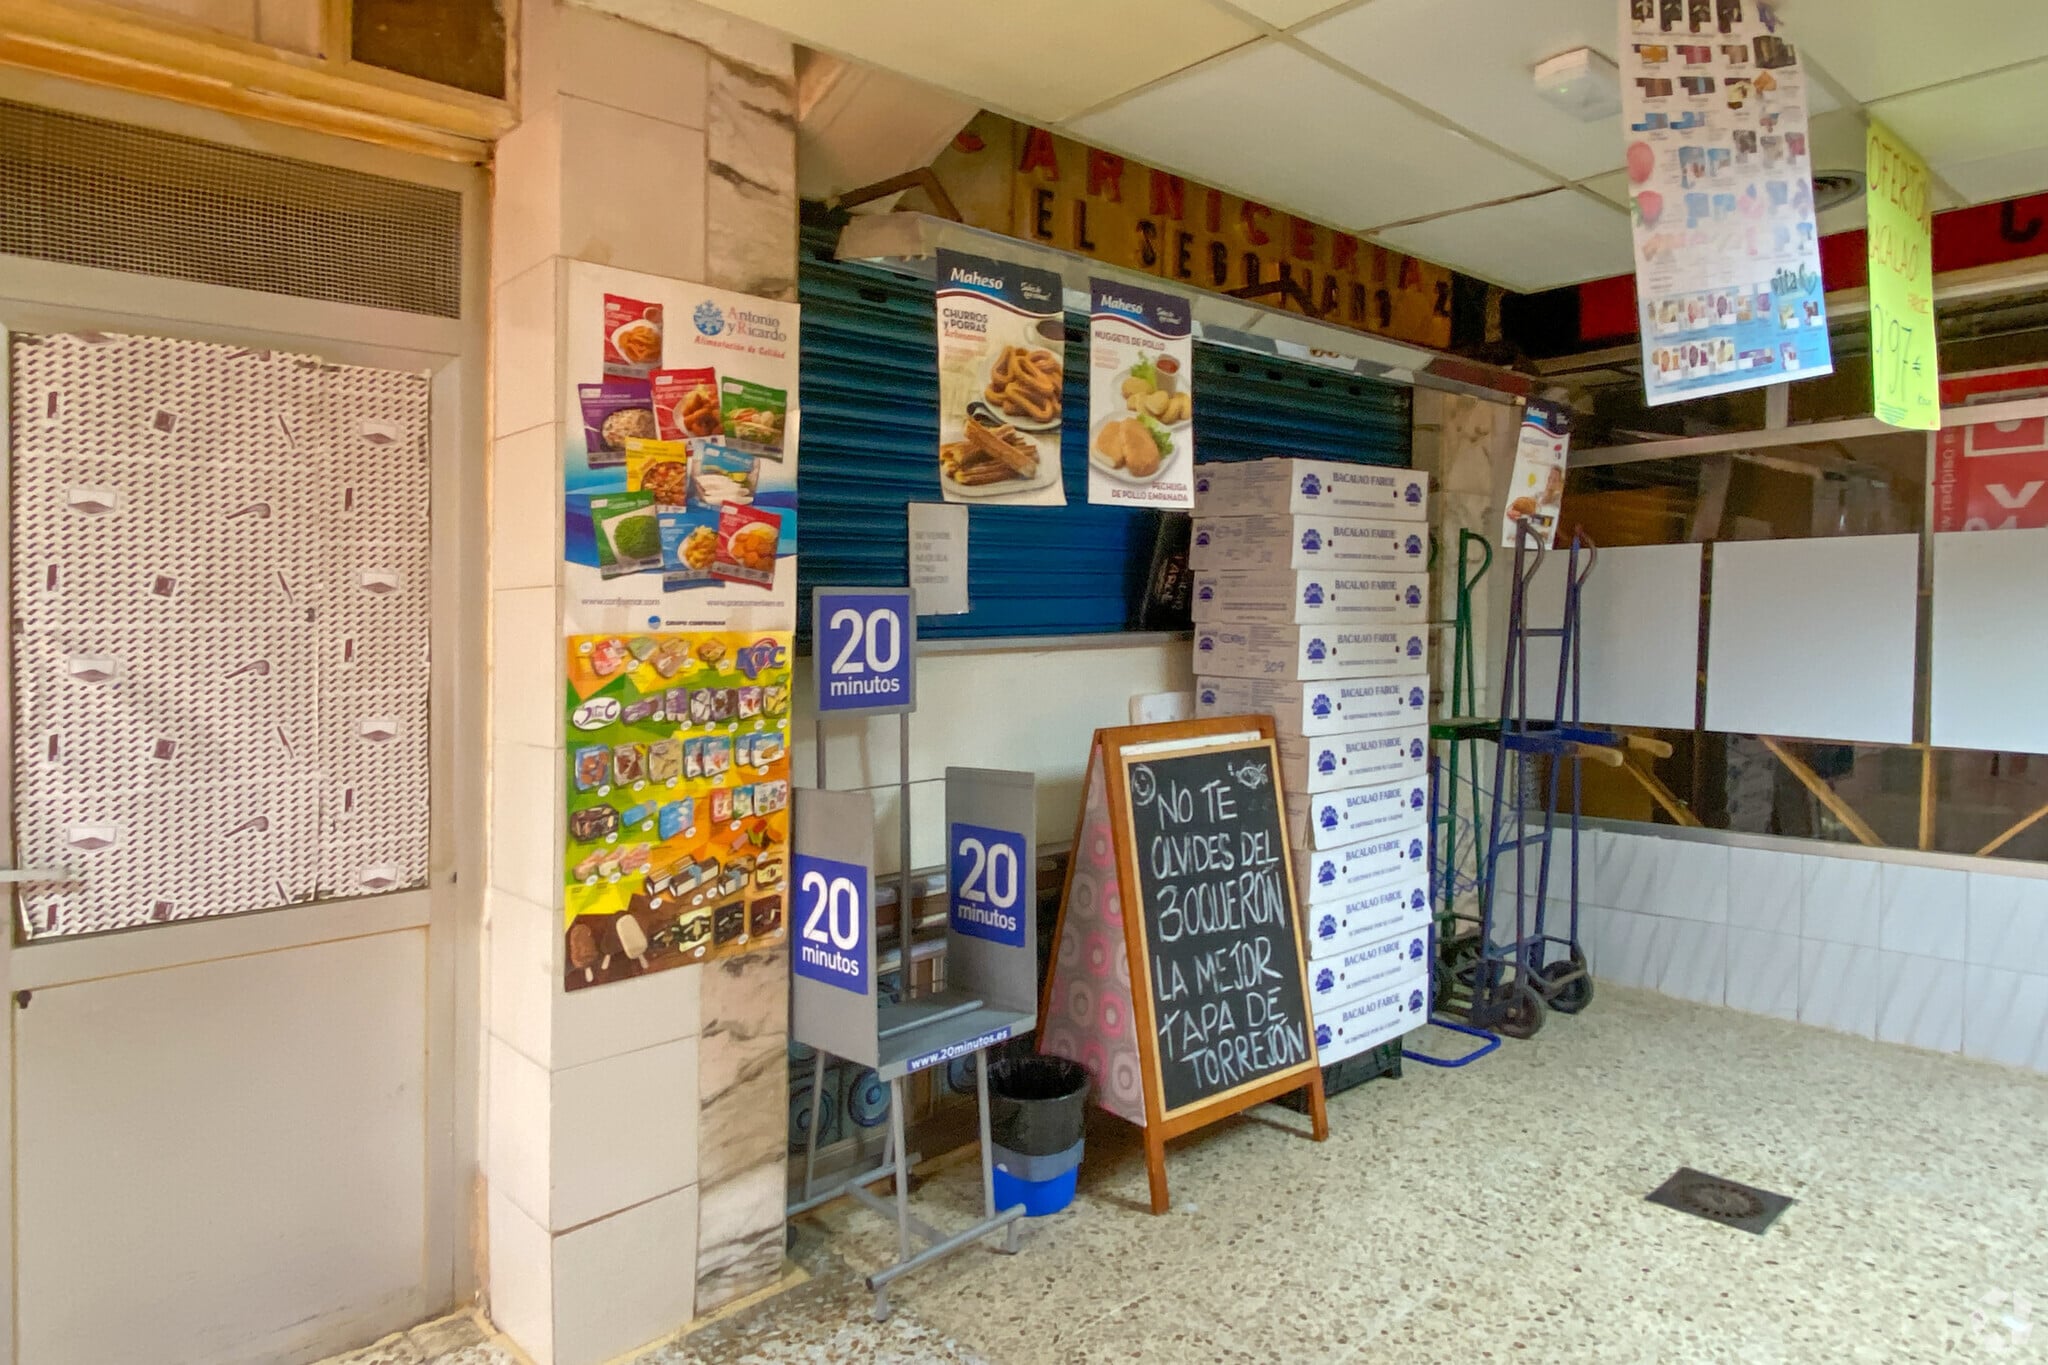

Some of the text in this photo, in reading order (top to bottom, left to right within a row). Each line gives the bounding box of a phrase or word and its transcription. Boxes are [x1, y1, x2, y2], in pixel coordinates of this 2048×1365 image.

[1033, 187, 1096, 251] EL
[950, 267, 1004, 290] Maheso
[1101, 294, 1143, 314] Maheso
[728, 306, 780, 328] Antonio
[943, 308, 988, 323] CHURROS
[951, 319, 987, 333] PORRAS
[1095, 330, 1130, 345] NUGGETS
[1142, 340, 1166, 352] POLLO
[1152, 480, 1188, 491] PECHUGA
[1333, 472, 1370, 484] BACALAO
[1111, 489, 1189, 502] DE POLLO EMPANADA
[1333, 526, 1370, 538] BACALAO
[1335, 579, 1370, 590] BACALAO
[829, 608, 901, 675] 20
[1337, 633, 1372, 645] BACALAO
[830, 676, 901, 697] minutos
[1340, 687, 1374, 699] BACALAO
[1345, 740, 1378, 753] BACALAO
[1157, 779, 1238, 830] NO TE
[1345, 793, 1379, 808] BACALAO
[1151, 829, 1280, 880] OLVIDES DEL
[1345, 844, 1378, 861] BACALAO
[958, 837, 1019, 909] 20
[801, 870, 860, 951] 20
[1345, 896, 1379, 914] BACALAO
[957, 903, 1017, 932] minutos
[801, 943, 860, 977] minutos
[1344, 948, 1377, 967] BACALAO
[1156, 954, 1189, 1002] LA
[1193, 936, 1284, 995] MEJOR
[1342, 1002, 1377, 1022] BACALAO
[1158, 986, 1286, 1062] TAPA DE
[910, 1029, 1009, 1070] www.20minutos.es
[1179, 1016, 1307, 1089] TORREJÓN
